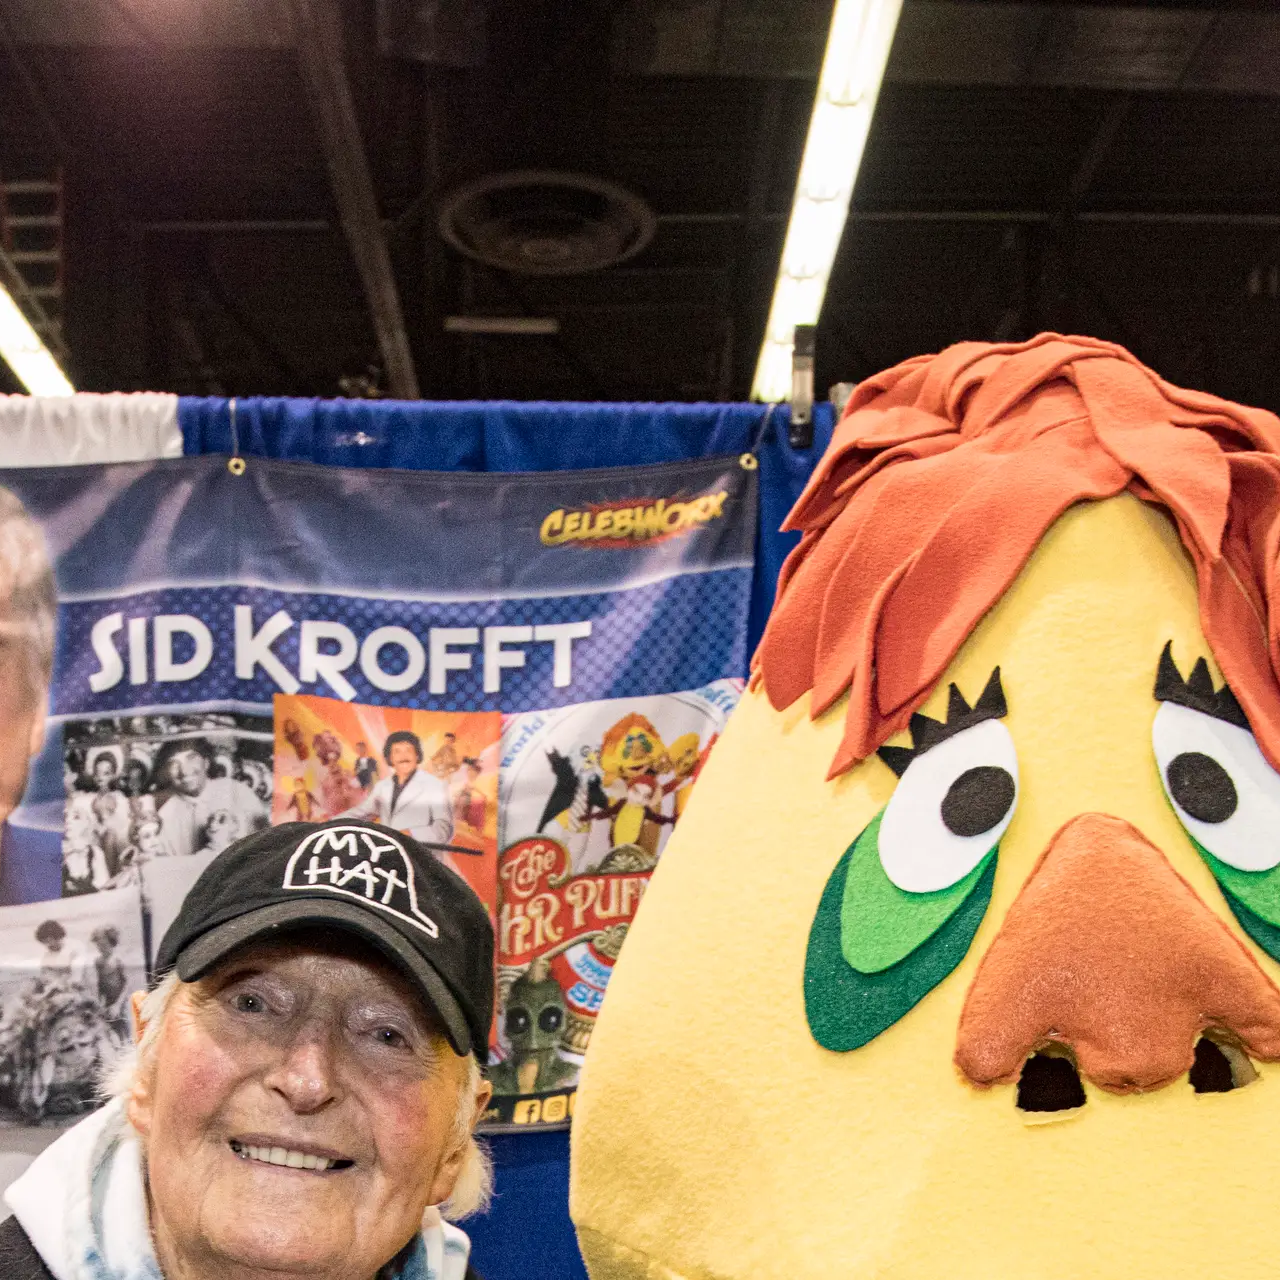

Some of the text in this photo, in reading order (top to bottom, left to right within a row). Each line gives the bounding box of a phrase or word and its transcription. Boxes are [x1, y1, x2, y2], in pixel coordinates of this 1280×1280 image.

[88, 605, 592, 702] SID KROFFT
[312, 833, 397, 863] MY
[500, 844, 558, 898] The
